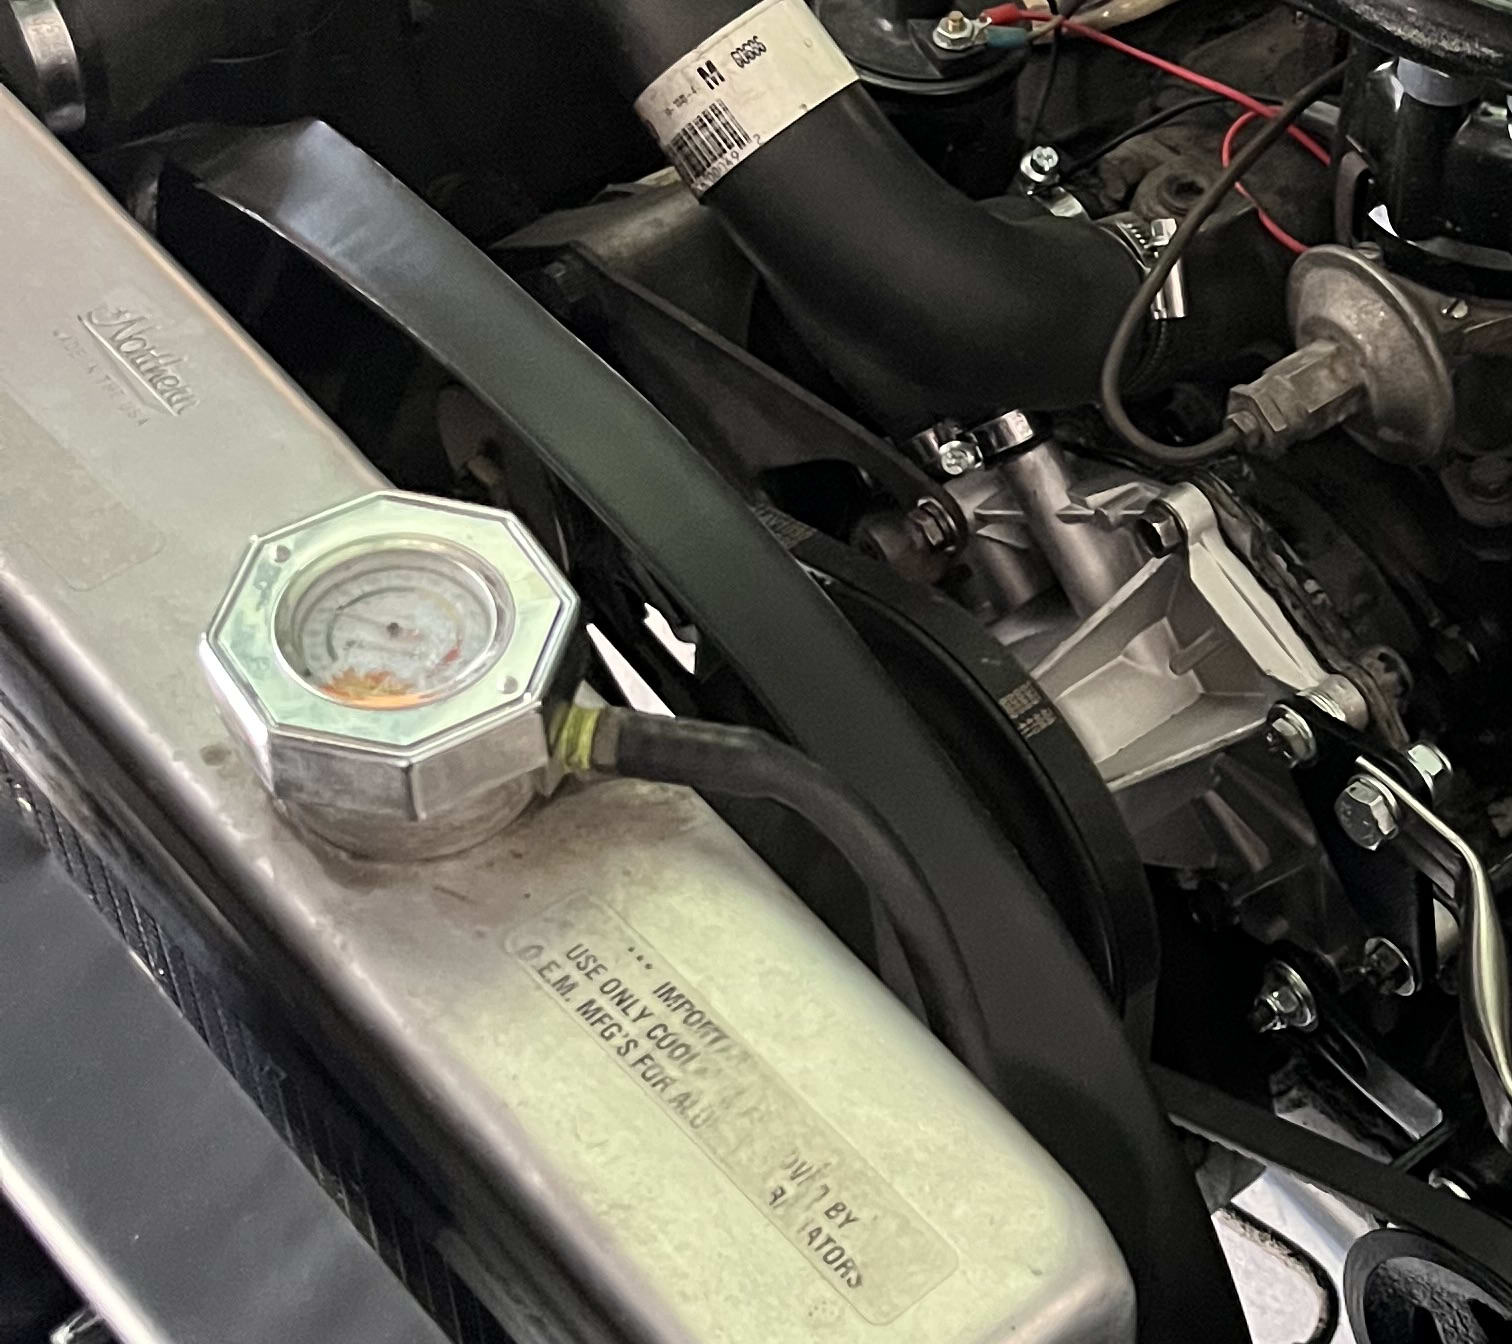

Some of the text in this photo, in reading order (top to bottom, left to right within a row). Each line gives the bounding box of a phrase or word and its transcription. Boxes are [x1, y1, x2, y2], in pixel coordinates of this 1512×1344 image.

[696, 59, 725, 90] M
[566, 943, 608, 980] USE
[600, 978, 654, 1023] ONLY
[824, 1201, 860, 1229] BY
[576, 998, 639, 1057] MFG'S
[631, 1053, 677, 1092] FOR
